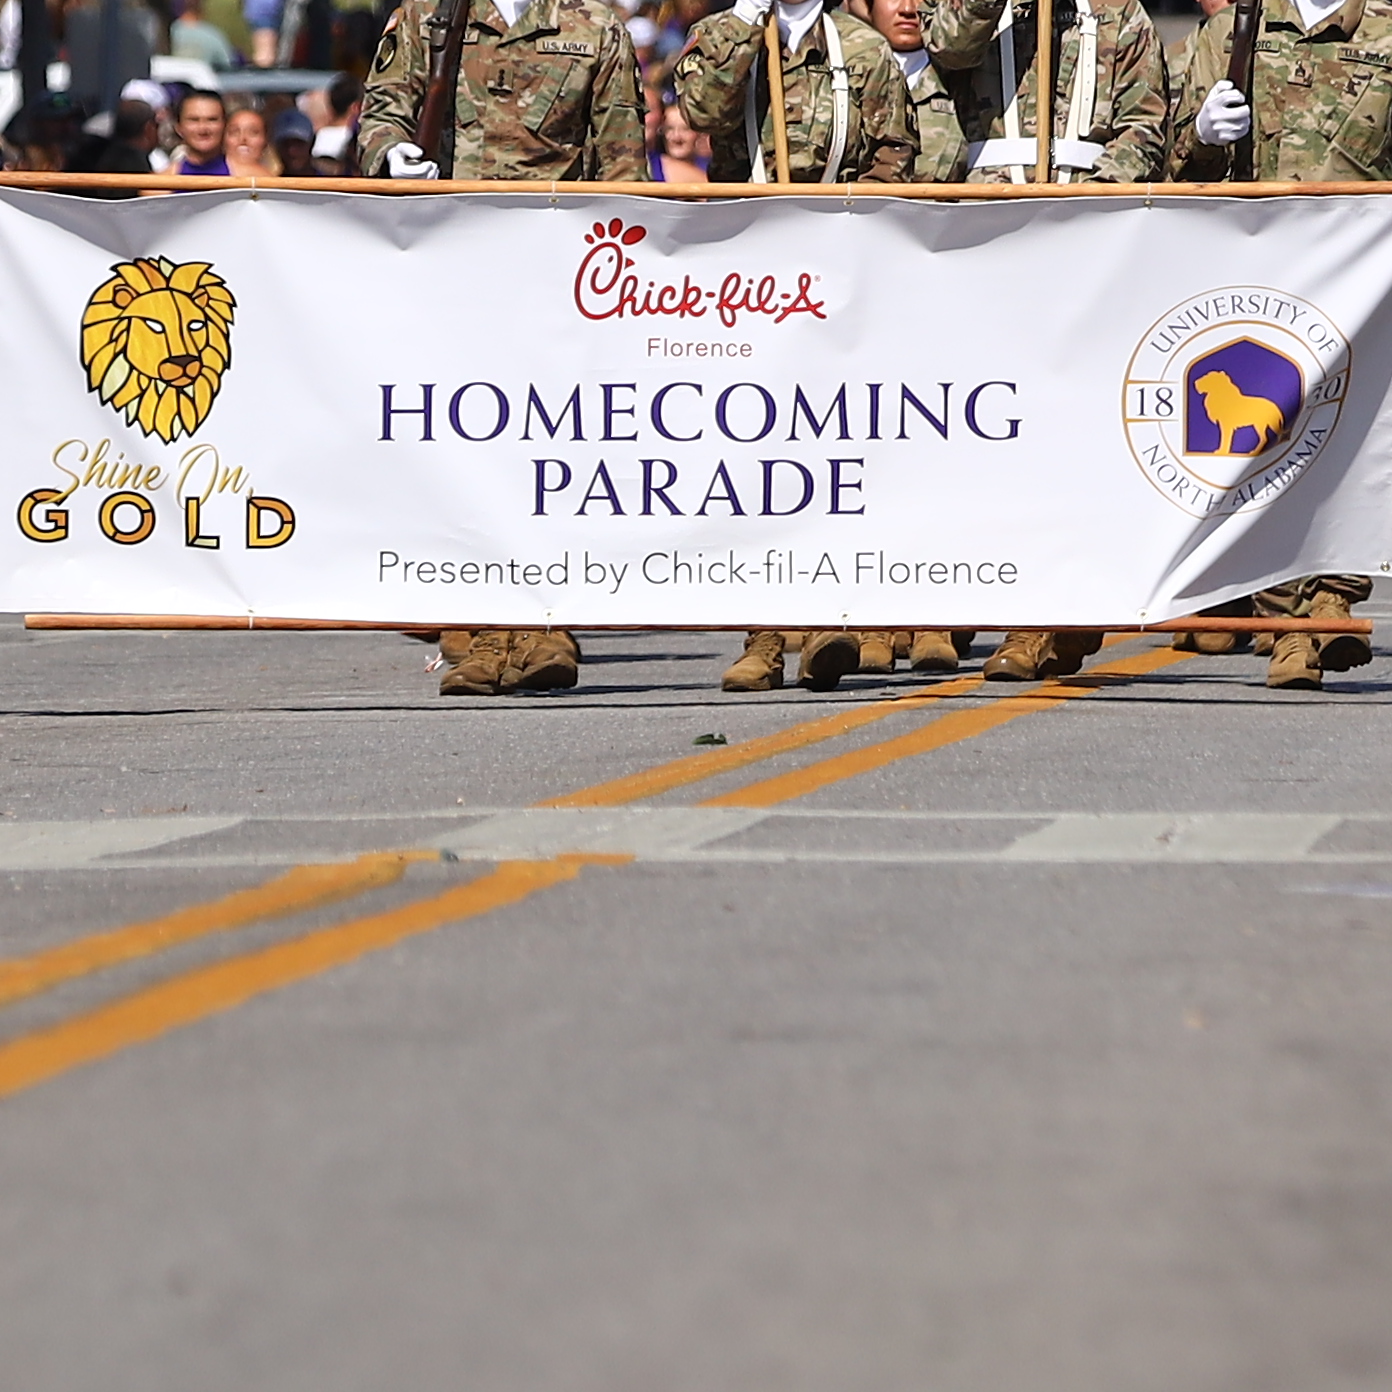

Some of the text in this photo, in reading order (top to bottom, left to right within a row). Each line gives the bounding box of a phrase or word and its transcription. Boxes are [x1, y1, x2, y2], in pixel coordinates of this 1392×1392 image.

[562, 41, 589, 53] ARMY
[1362, 50, 1391, 65] ARMY
[647, 338, 753, 357] Florence
[1150, 294, 1340, 354] UNIVERSITY OF
[377, 381, 1023, 442] HOMECOMING
[1134, 387, 1174, 417] 18
[41, 438, 170, 504] Shine
[530, 458, 866, 516] PARADE
[1142, 427, 1328, 513] NORTH ALABAMA
[17, 488, 296, 549] GOLD
[379, 549, 1019, 595] Presented by Chick-fil-A Florence
